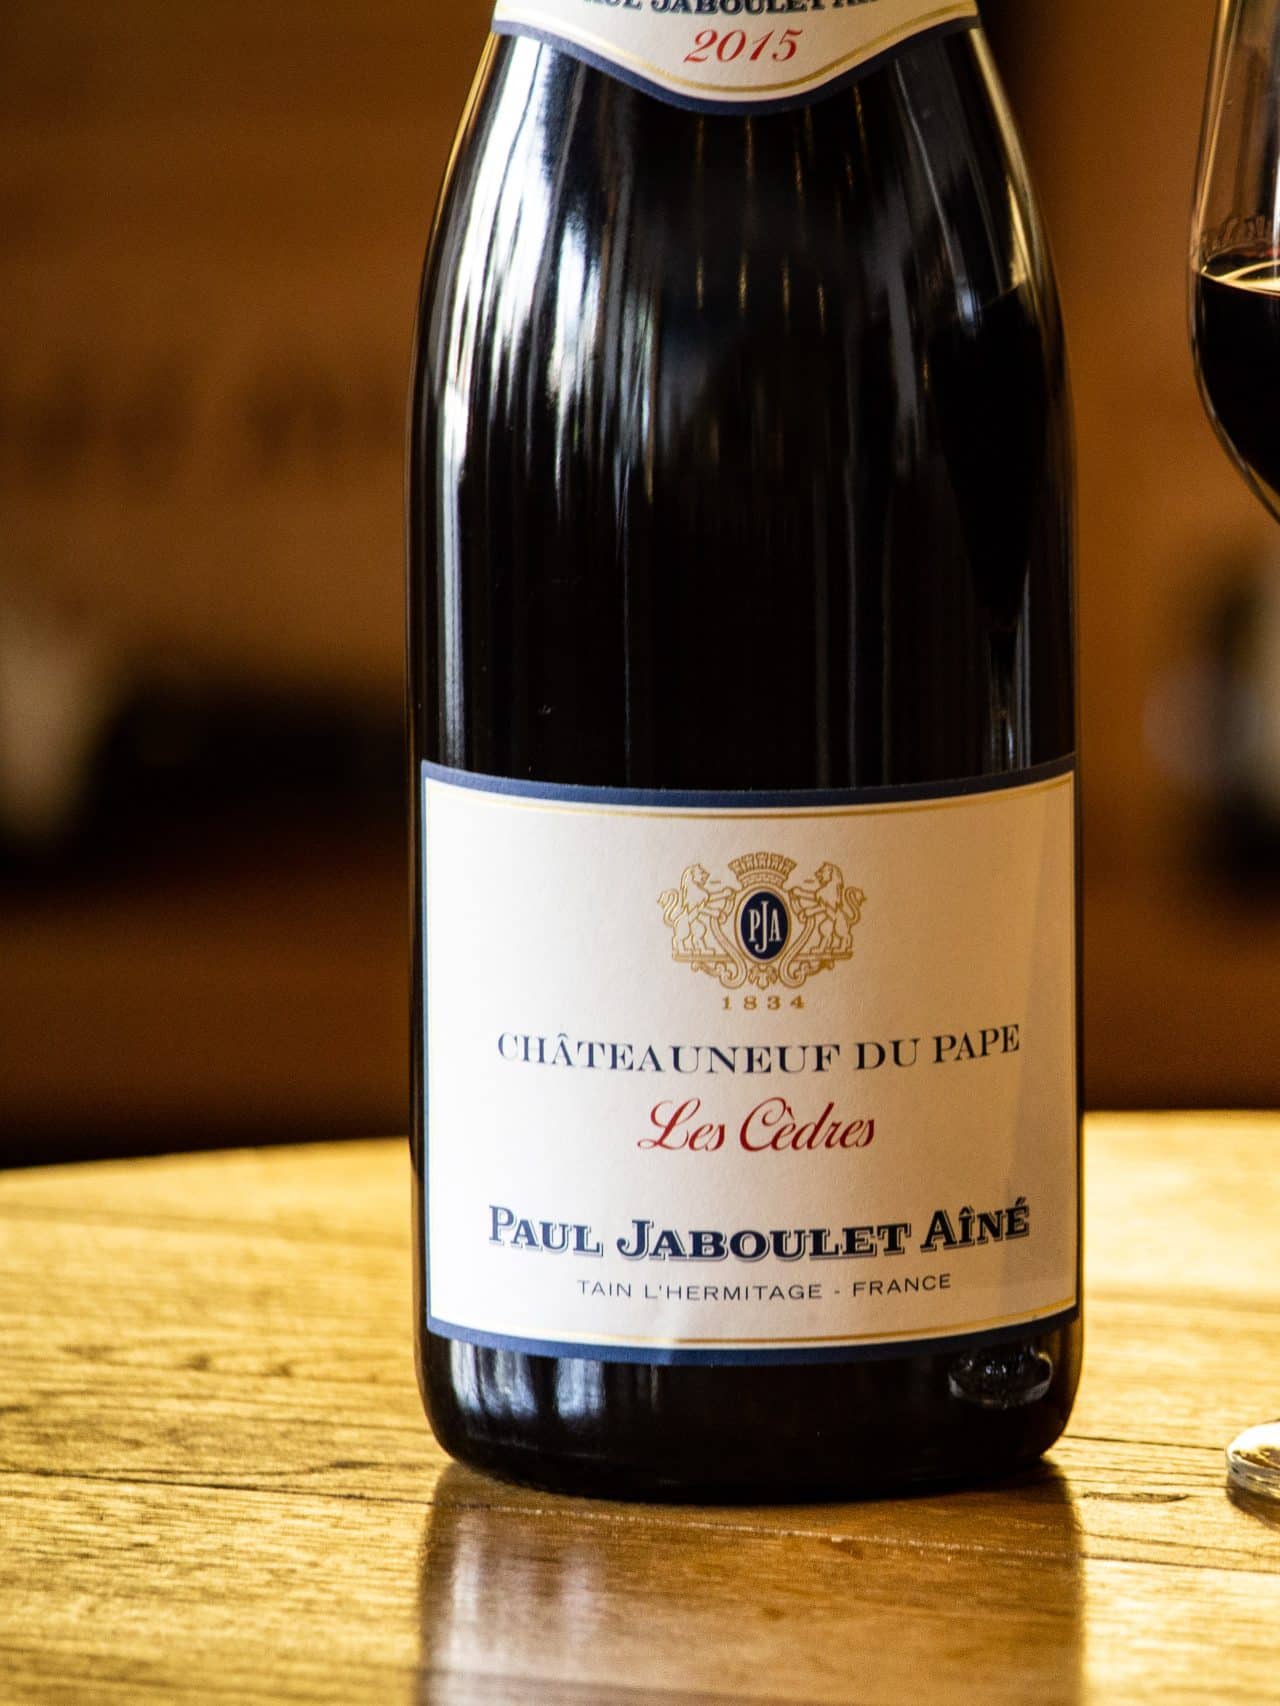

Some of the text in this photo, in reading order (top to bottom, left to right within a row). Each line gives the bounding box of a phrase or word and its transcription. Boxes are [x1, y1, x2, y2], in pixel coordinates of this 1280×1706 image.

[683, 28, 803, 63] 2015
[748, 900, 782, 953] PJA
[721, 996, 806, 1010] 1834
[497, 1023, 1021, 1075] CHÂTEAUNEUF DU PAPE
[636, 1096, 876, 1152] Les Cèdres
[488, 1195, 1031, 1263] PAUL JABOULET AÎNÉ
[577, 1279, 632, 1298] TAIN
[644, 1283, 823, 1301] L'HERMITAGE
[852, 1273, 952, 1297] FRANCE
